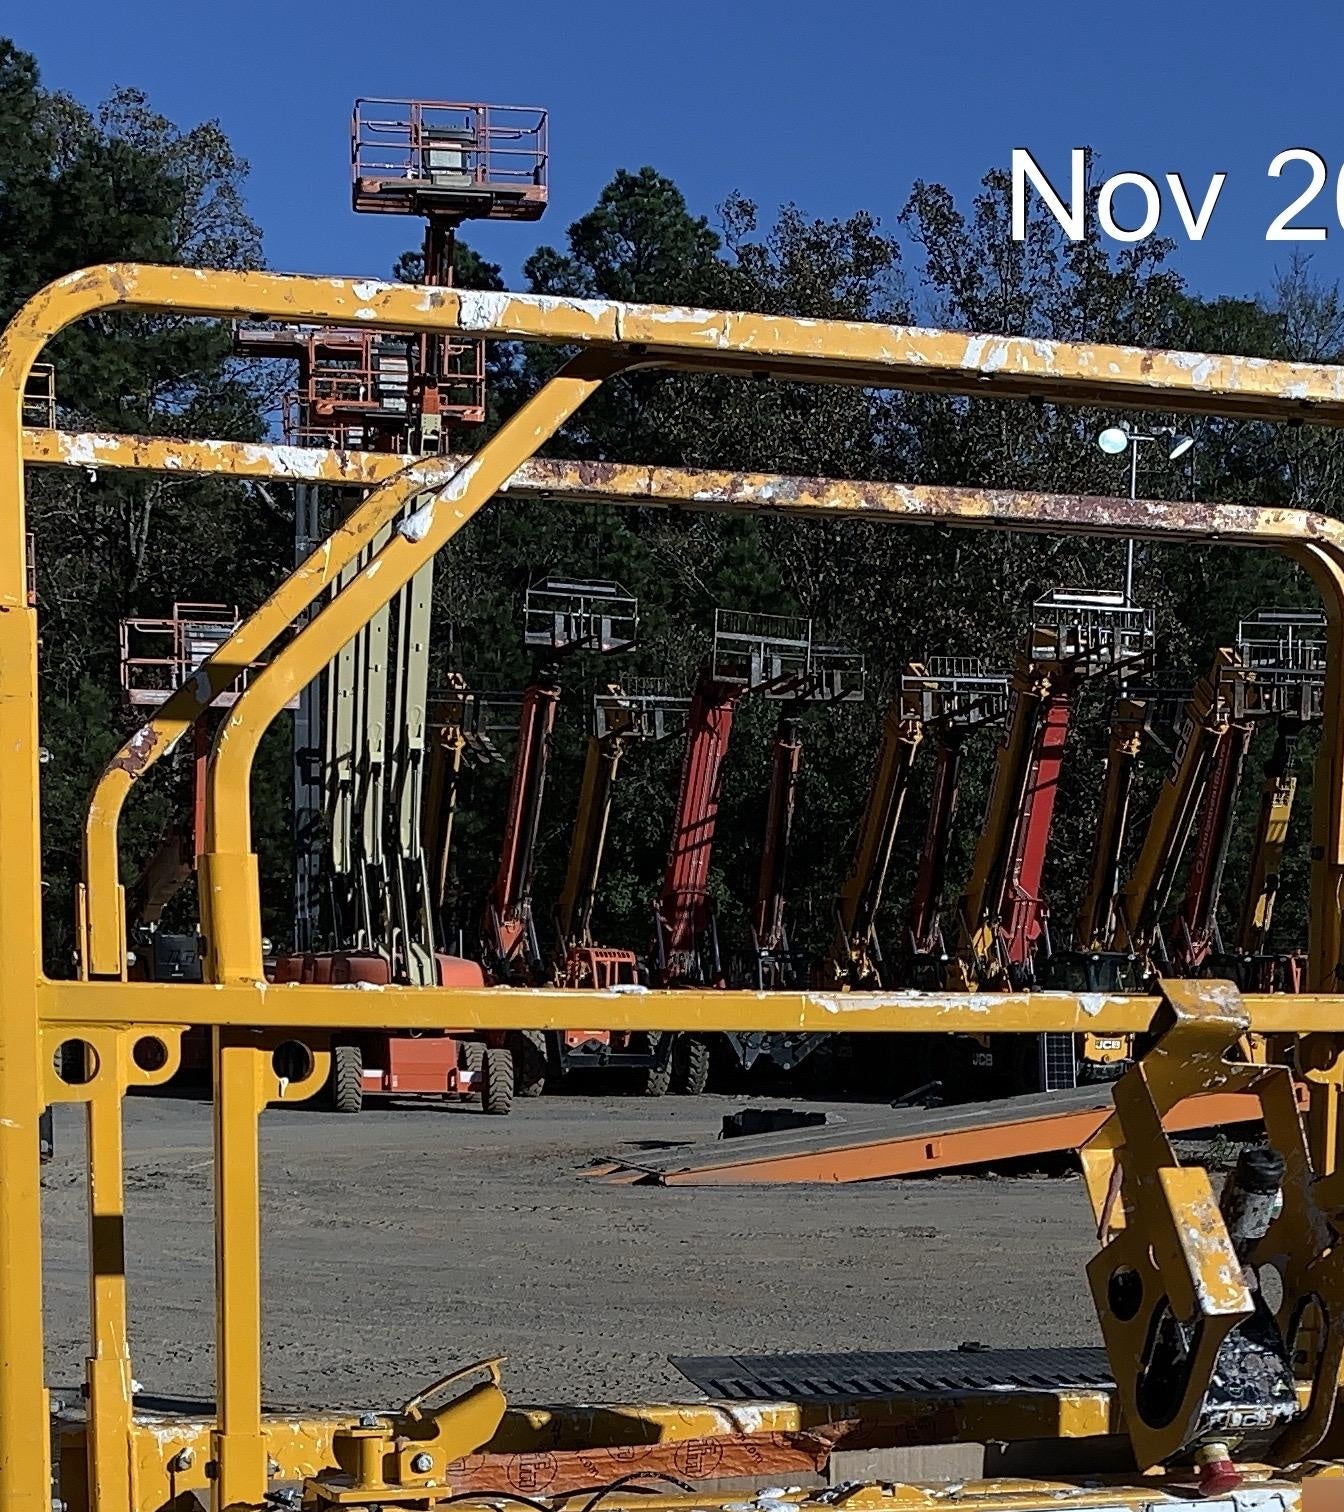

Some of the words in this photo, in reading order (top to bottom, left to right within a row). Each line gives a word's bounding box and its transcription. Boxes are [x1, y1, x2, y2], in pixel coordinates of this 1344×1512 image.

[1169, 717, 1196, 788] JCB
[1095, 1038, 1121, 1050] JCB
[972, 1053, 993, 1067] JCB
